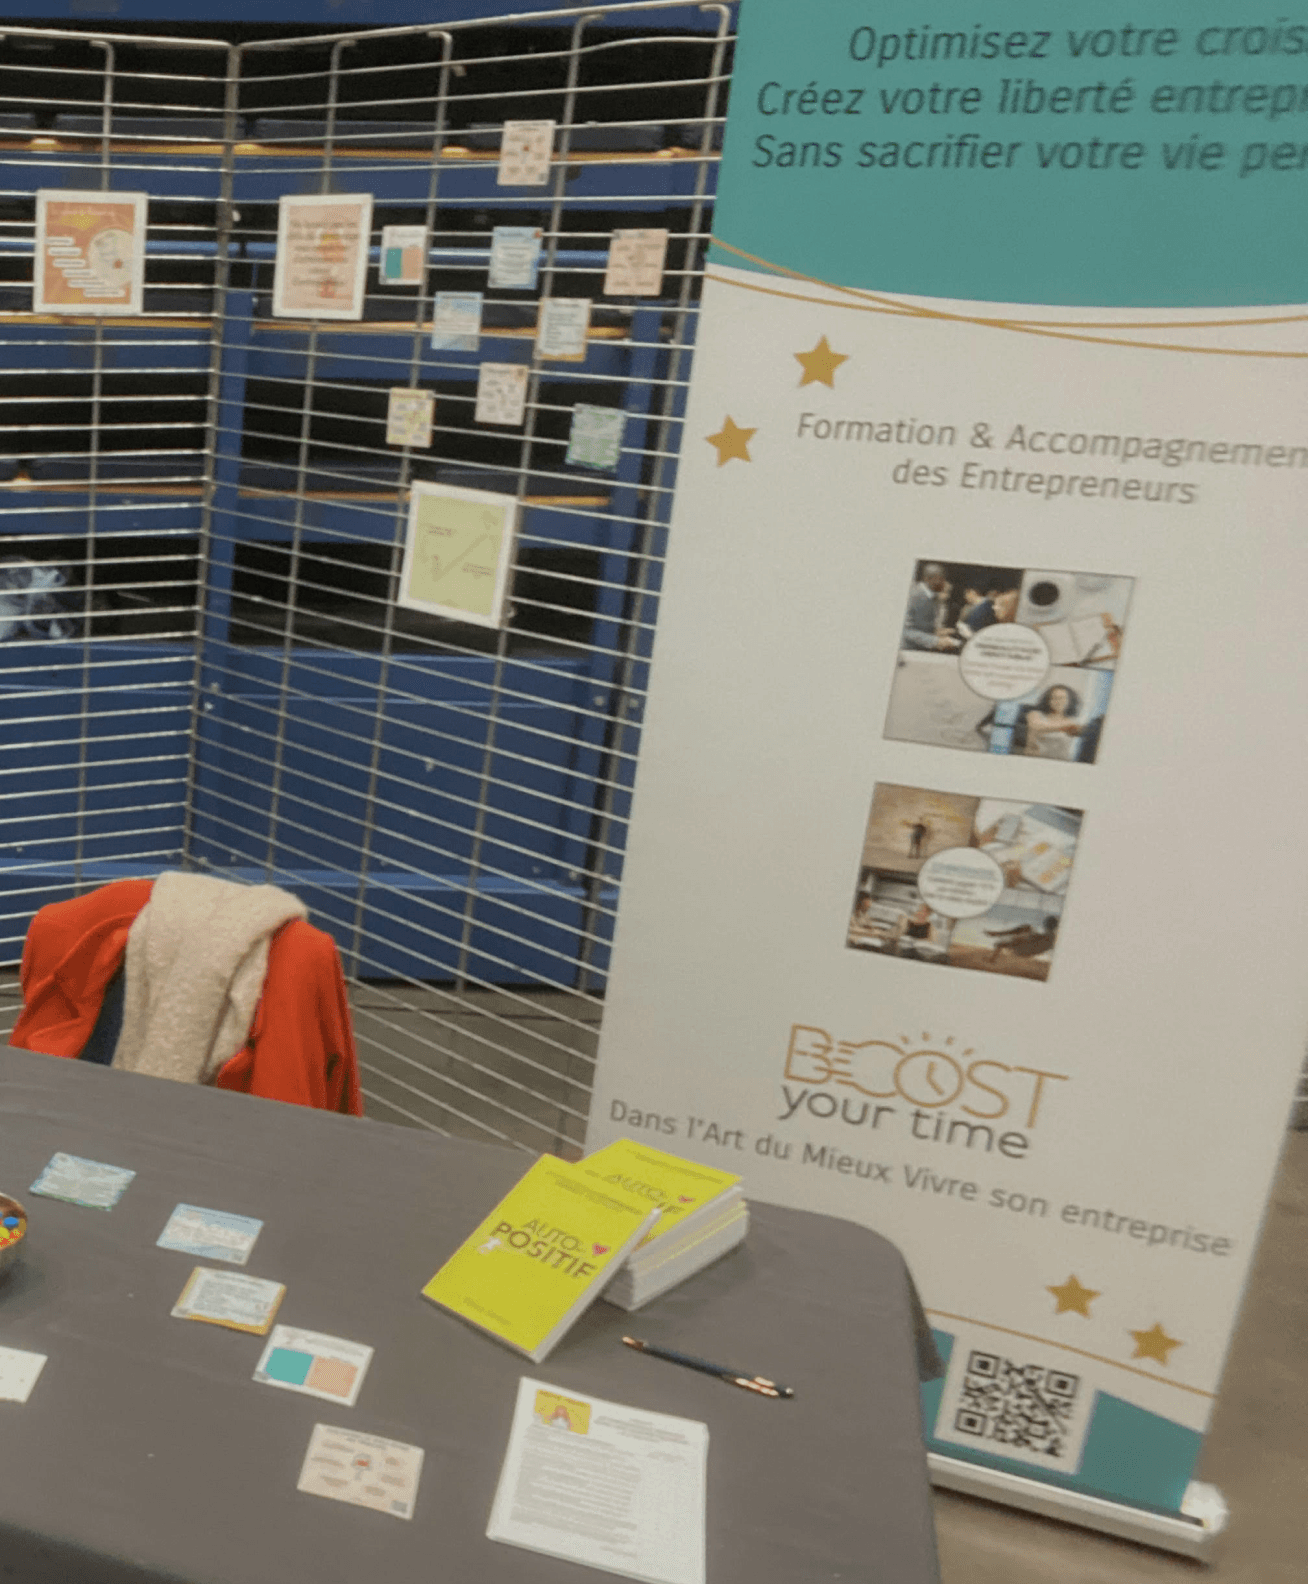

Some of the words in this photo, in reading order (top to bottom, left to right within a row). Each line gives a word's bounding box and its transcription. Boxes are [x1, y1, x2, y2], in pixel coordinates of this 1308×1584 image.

[849, 23, 1052, 68] Optimisez
[1067, 22, 1179, 57] votre
[757, 80, 866, 116] Créez
[879, 82, 982, 115] votre
[998, 76, 1136, 115] liberté
[752, 133, 843, 168] Sans
[857, 133, 1023, 168] sacrifier
[1036, 137, 1145, 169] votre
[1161, 133, 1226, 171] vie
[797, 412, 956, 447] Formation
[969, 421, 994, 449] &
[892, 458, 949, 487] des
[960, 461, 1199, 505] Entrepreneurs
[777, 1084, 896, 1130] your
[911, 1108, 1029, 1160] time
[609, 1098, 678, 1136] Dans
[687, 1116, 744, 1151] l'Art
[754, 1133, 791, 1161] du
[802, 1142, 892, 1184] Mieux
[902, 1163, 979, 1202] Vivre
[988, 1187, 1048, 1218] son
[1059, 1201, 1233, 1257] entreprise
[489, 1220, 598, 1278] POSITIF
